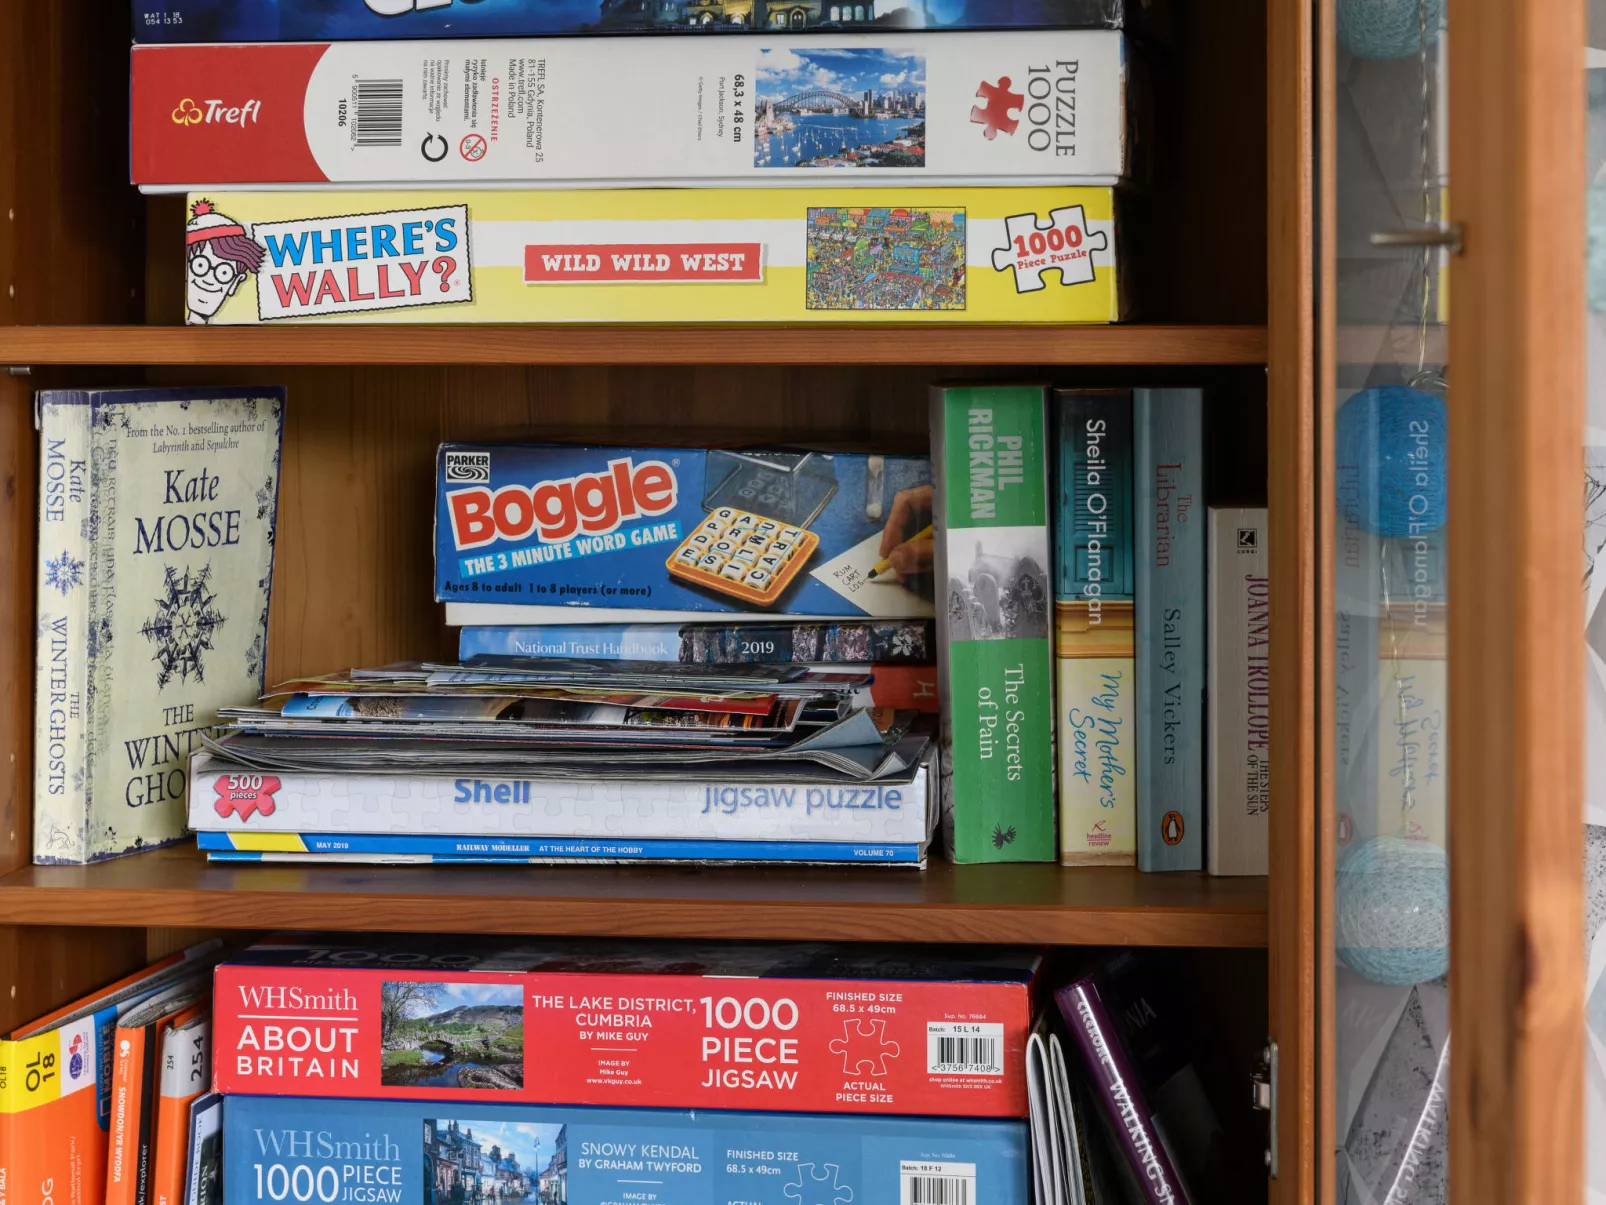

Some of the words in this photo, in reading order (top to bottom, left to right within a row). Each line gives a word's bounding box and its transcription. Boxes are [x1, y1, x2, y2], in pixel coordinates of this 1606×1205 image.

[470, 59, 478, 80] ryzyko
[508, 58, 516, 80] Made
[527, 58, 536, 87] 81-155
[537, 58, 546, 82] TREFL
[508, 82, 516, 90] in
[518, 58, 526, 114] www.trefl.com
[536, 84, 545, 98] SA,
[732, 74, 744, 97] 68,3
[204, 99, 262, 128] Trefl
[338, 98, 347, 127] 10206
[490, 78, 500, 142] OSTRZEŻENIE
[508, 92, 516, 118] Poland
[525, 90, 535, 119] Gdynia,
[734, 110, 744, 124] 48
[1028, 64, 1051, 152] 1000
[1055, 60, 1079, 156] PUZZLE
[526, 122, 534, 148] Poland
[536, 100, 544, 150] Kontenerowa
[734, 126, 742, 142] cm
[535, 152, 544, 162] 25
[264, 218, 458, 268] WHERE'S
[1013, 225, 1083, 258] 1000
[542, 254, 600, 272] WILD
[611, 254, 670, 272] WILD
[680, 254, 745, 271] WEST
[1016, 258, 1046, 270] Piece
[1050, 250, 1087, 263] Puzzle
[270, 255, 457, 309] WALLY?
[152, 439, 190, 454] Labyrinth
[191, 439, 205, 451] and
[206, 437, 240, 454] Sepulchre
[1086, 418, 1106, 486] Sheila
[446, 455, 490, 467] PARKER
[968, 408, 996, 519] RICKMAN
[997, 436, 1024, 490] PHIL
[46, 438, 66, 522] MOSSE
[68, 460, 86, 504] Kate
[163, 467, 220, 504] Kate
[450, 459, 675, 548] Boggle
[1156, 462, 1182, 568] Librarian
[1177, 494, 1192, 524] The
[132, 510, 241, 555] MOSSE
[464, 557, 496, 576] THE
[496, 554, 508, 568] 3
[510, 543, 572, 566] MINUTE
[576, 533, 628, 556] WORD
[630, 523, 678, 546] GAME
[1083, 493, 1107, 625] O'Flanagan
[832, 564, 853, 580] RUM
[841, 569, 860, 586] CART
[445, 582, 469, 592] Ages
[472, 582, 478, 591] 8
[482, 583, 492, 592] to
[494, 582, 522, 592] adult
[1245, 574, 1268, 648] JOANNA
[516, 641, 566, 654] National
[569, 642, 600, 654] Trust
[603, 642, 667, 655] Handbook
[742, 641, 774, 654] 2019
[1160, 608, 1181, 674] Salley
[50, 616, 68, 708] WINTER
[1004, 664, 1024, 704] The
[1091, 671, 1122, 712] My
[69, 692, 80, 719] THE
[978, 687, 998, 710] of
[1248, 653, 1268, 751] TROLLOPE
[163, 704, 194, 726] THE
[1164, 682, 1181, 766] Vickers
[978, 714, 998, 760] Pain
[1006, 710, 1025, 781] Secrets
[1068, 708, 1095, 784] Secret
[48, 710, 66, 796] GHOSTS
[1095, 717, 1126, 809] Mother's
[228, 776, 262, 790] 500
[230, 792, 258, 800] pieces
[454, 778, 530, 804] Shell
[702, 783, 796, 814] jigsaw
[806, 786, 902, 816] puzzle
[332, 842, 349, 850] 2019
[456, 844, 489, 852] RAILWAY
[491, 844, 530, 852] MODELLER
[618, 846, 643, 854] HOBBY
[854, 849, 884, 857] VOLUME
[238, 986, 358, 1012] WHSmith
[532, 995, 564, 1010] THE
[568, 996, 613, 1011] LAKE
[617, 997, 696, 1014] DISTRICT,
[826, 991, 878, 1002] FINISHED
[880, 992, 903, 1002] SIZE
[832, 1004, 855, 1014] 68.5
[857, 1006, 864, 1014] x
[867, 1004, 896, 1014] 49cm
[576, 1013, 652, 1028] CUMBRIA
[700, 996, 798, 1031] 1000
[236, 1025, 360, 1054] ABOUT
[580, 1031, 595, 1040] BY
[597, 1032, 624, 1041] MIKE
[626, 1032, 648, 1042] GUY
[166, 1055, 174, 1070] 254
[190, 1036, 204, 1082] 254
[702, 1037, 799, 1064] PIECE
[26, 1052, 41, 1092] OL
[42, 1052, 55, 1083] 18
[236, 1056, 360, 1079] BRITAIN
[599, 1068, 616, 1076] Mike
[617, 1068, 630, 1077] Guy
[702, 1069, 798, 1090] JIGSAW
[586, 1077, 642, 1086] www.vkguy.co.uk
[843, 1082, 886, 1092] ACTUAL
[836, 1093, 868, 1103] PIECE
[870, 1094, 894, 1103] SIZE
[116, 1086, 126, 1146] SNOWDON/YR
[254, 1128, 400, 1160] WHSmith
[581, 1142, 637, 1157] SNOWY
[642, 1145, 700, 1160] KENDAL
[726, 1150, 774, 1160] FINISHED
[777, 1152, 799, 1162] SIZE
[113, 1147, 124, 1182] WYDDFA
[342, 1165, 402, 1185] PIECE
[578, 1159, 592, 1168] BY
[595, 1160, 643, 1170] GRAHAM
[646, 1162, 702, 1173] TWYFORD
[254, 1164, 339, 1202] 1000
[342, 1187, 402, 1205] JIGSAW
